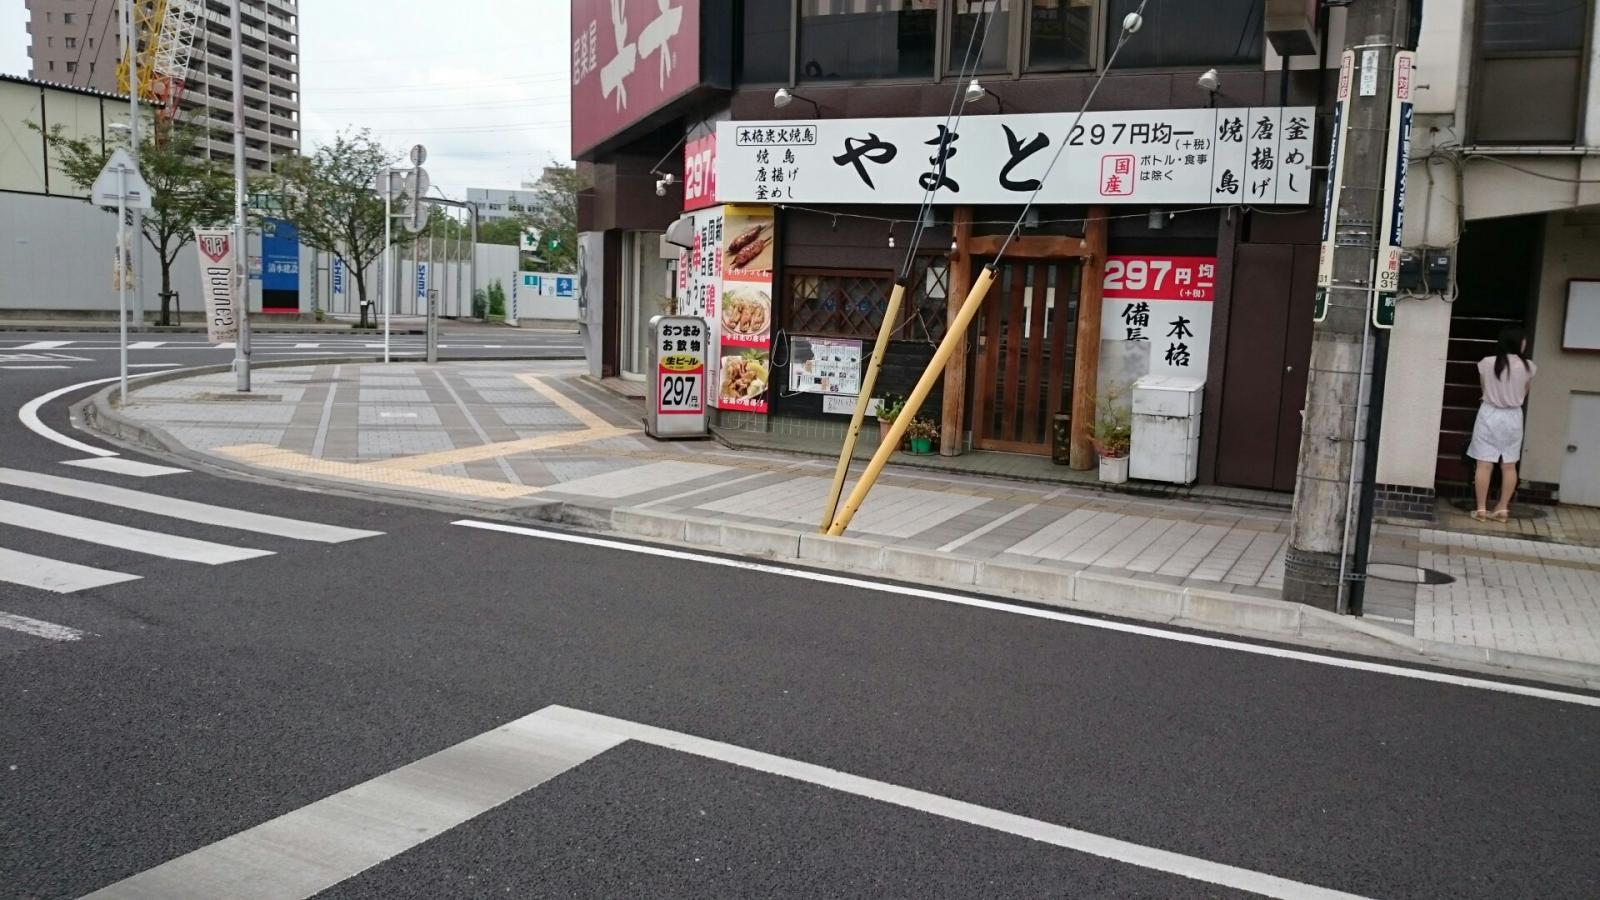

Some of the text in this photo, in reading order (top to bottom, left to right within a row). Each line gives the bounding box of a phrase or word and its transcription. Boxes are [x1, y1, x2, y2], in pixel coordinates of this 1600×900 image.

[739, 129, 815, 144] 本格炭火焼鳥
[1069, 122, 1195, 146] 297円均一
[755, 148, 796, 164] 焼鳥
[832, 123, 1050, 194] やまと
[1215, 117, 1244, 195] 焼鳥
[1251, 116, 1275, 199] 唐揚げ
[1284, 116, 1310, 193] 釜めし
[754, 167, 799, 182] 唐揚げ
[1104, 157, 1131, 193] 国産
[1139, 169, 1174, 182] は除く
[754, 185, 794, 200] 釜めし
[663, 324, 701, 337] おつまみ
[663, 339, 701, 352] お飲物
[1164, 315, 1194, 367] 本格
[665, 355, 699, 366] 生ビール
[662, 376, 698, 406] 297円
